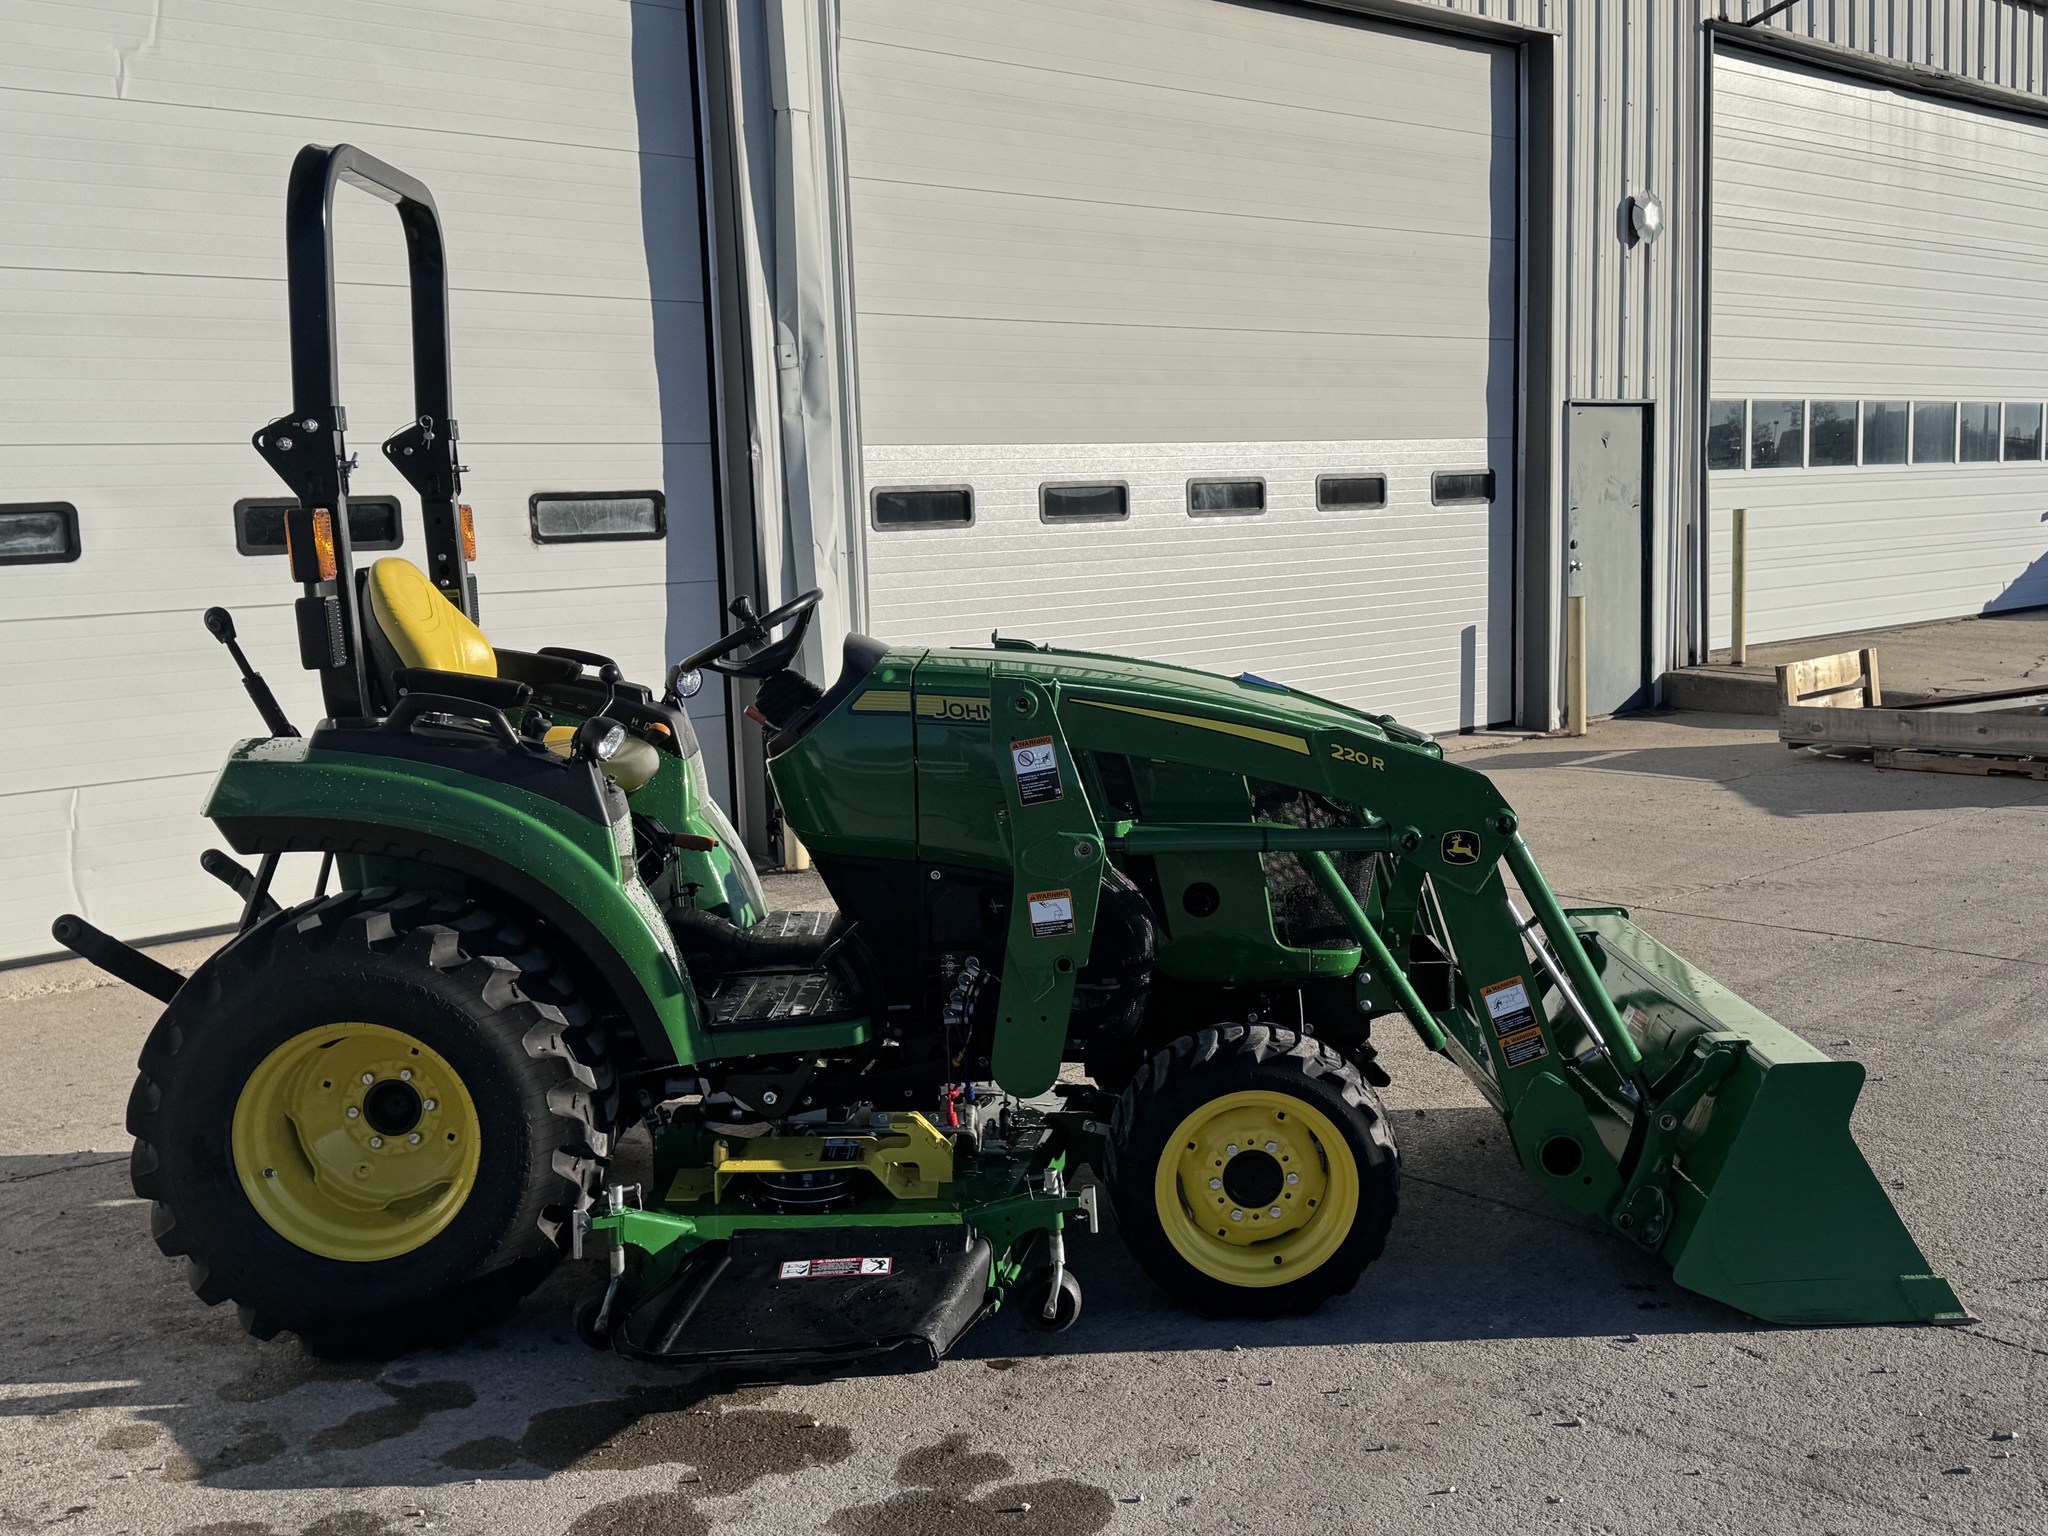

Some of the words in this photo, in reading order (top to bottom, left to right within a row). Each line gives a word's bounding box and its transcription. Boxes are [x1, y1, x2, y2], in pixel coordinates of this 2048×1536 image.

[1019, 736, 1051, 748] WARNING
[1036, 890, 1068, 899] WARNING
[1492, 979, 1518, 991] WARNING
[1510, 1031, 1537, 1043] WARNING
